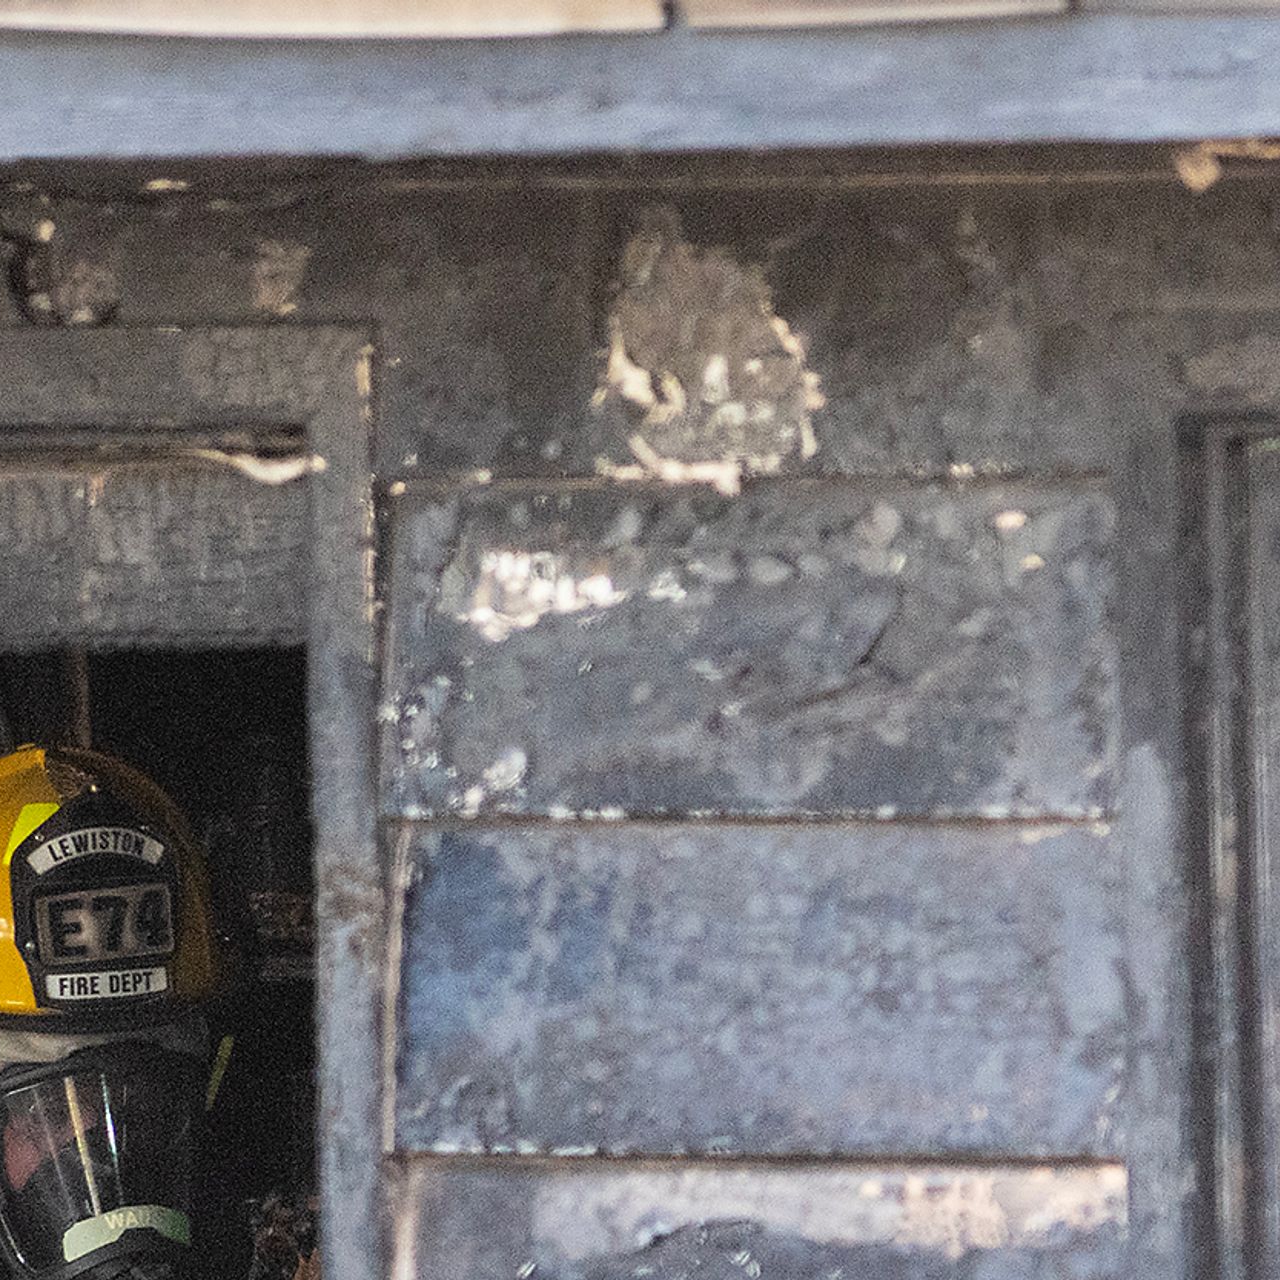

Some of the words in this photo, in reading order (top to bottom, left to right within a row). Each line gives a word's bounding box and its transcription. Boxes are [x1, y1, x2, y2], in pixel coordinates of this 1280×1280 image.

[47, 830, 146, 863] LEWISTON
[59, 974, 100, 997] FIRE
[109, 970, 154, 994] DEPT
